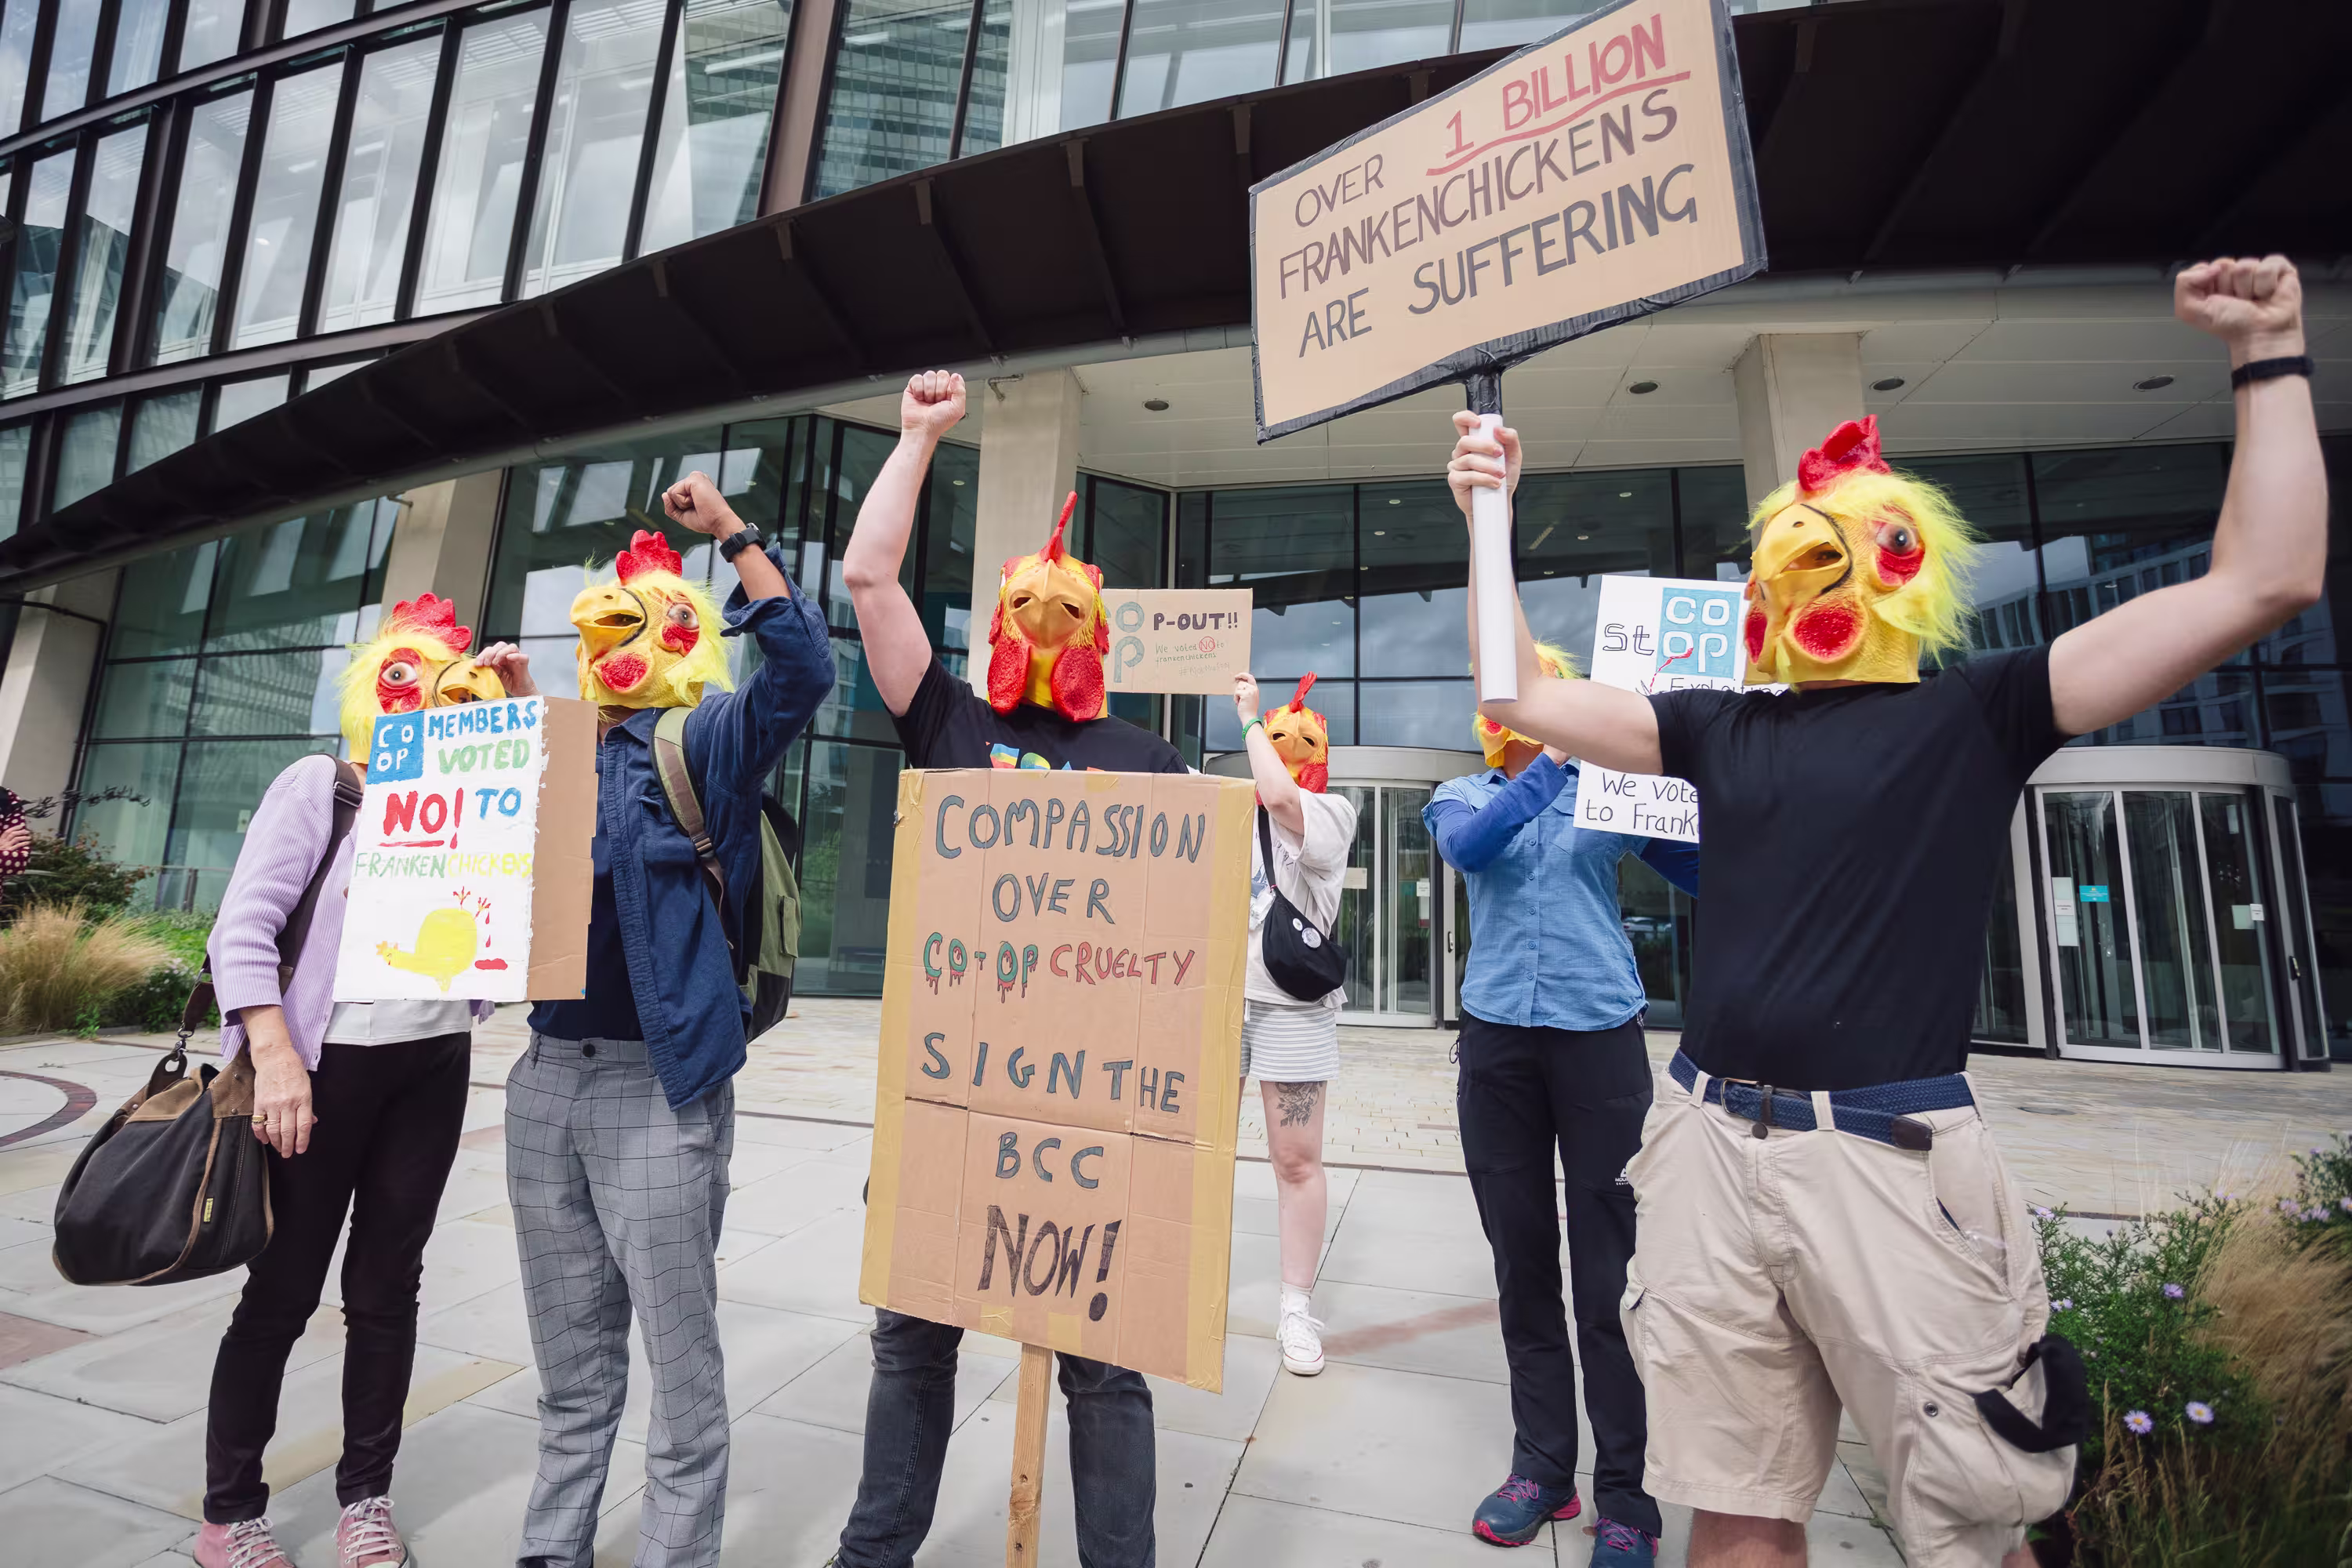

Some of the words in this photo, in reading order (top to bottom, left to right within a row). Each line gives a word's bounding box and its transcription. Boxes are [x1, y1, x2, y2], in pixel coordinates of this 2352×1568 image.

[1295, 154, 1384, 227] OVER
[1445, 110, 1474, 159] 1
[1501, 13, 1666, 131] BILLION
[1279, 89, 1677, 299] FRANKENCHICKENS
[1298, 287, 1372, 358] ARE
[1408, 164, 1697, 314] SUFFERING
[1154, 612, 1238, 630] P-OUT!!
[1156, 643, 1168, 654] We
[1174, 643, 1197, 652] voted
[1200, 638, 1214, 651] NO
[1216, 640, 1225, 648] to
[379, 724, 414, 748] CO
[428, 700, 538, 741] MEMBERS
[376, 748, 408, 772] OP
[437, 739, 531, 775] VOTED
[1602, 772, 1636, 797] We
[383, 787, 464, 850] NO!
[474, 786, 521, 820] TO
[935, 794, 1205, 862] COMPASSION
[1586, 799, 1613, 822] to
[1633, 804, 1700, 837] Frank
[354, 851, 533, 879] FRANKENCHICKENS
[992, 873, 1115, 924] OVER
[923, 932, 1039, 1002] CO-OP
[1050, 942, 1195, 985] CRUELTY
[920, 1032, 1085, 1099] SIGN
[1103, 1059, 1185, 1113] THE
[995, 1131, 1104, 1189] BCC
[978, 1204, 1122, 1322] NOW!
